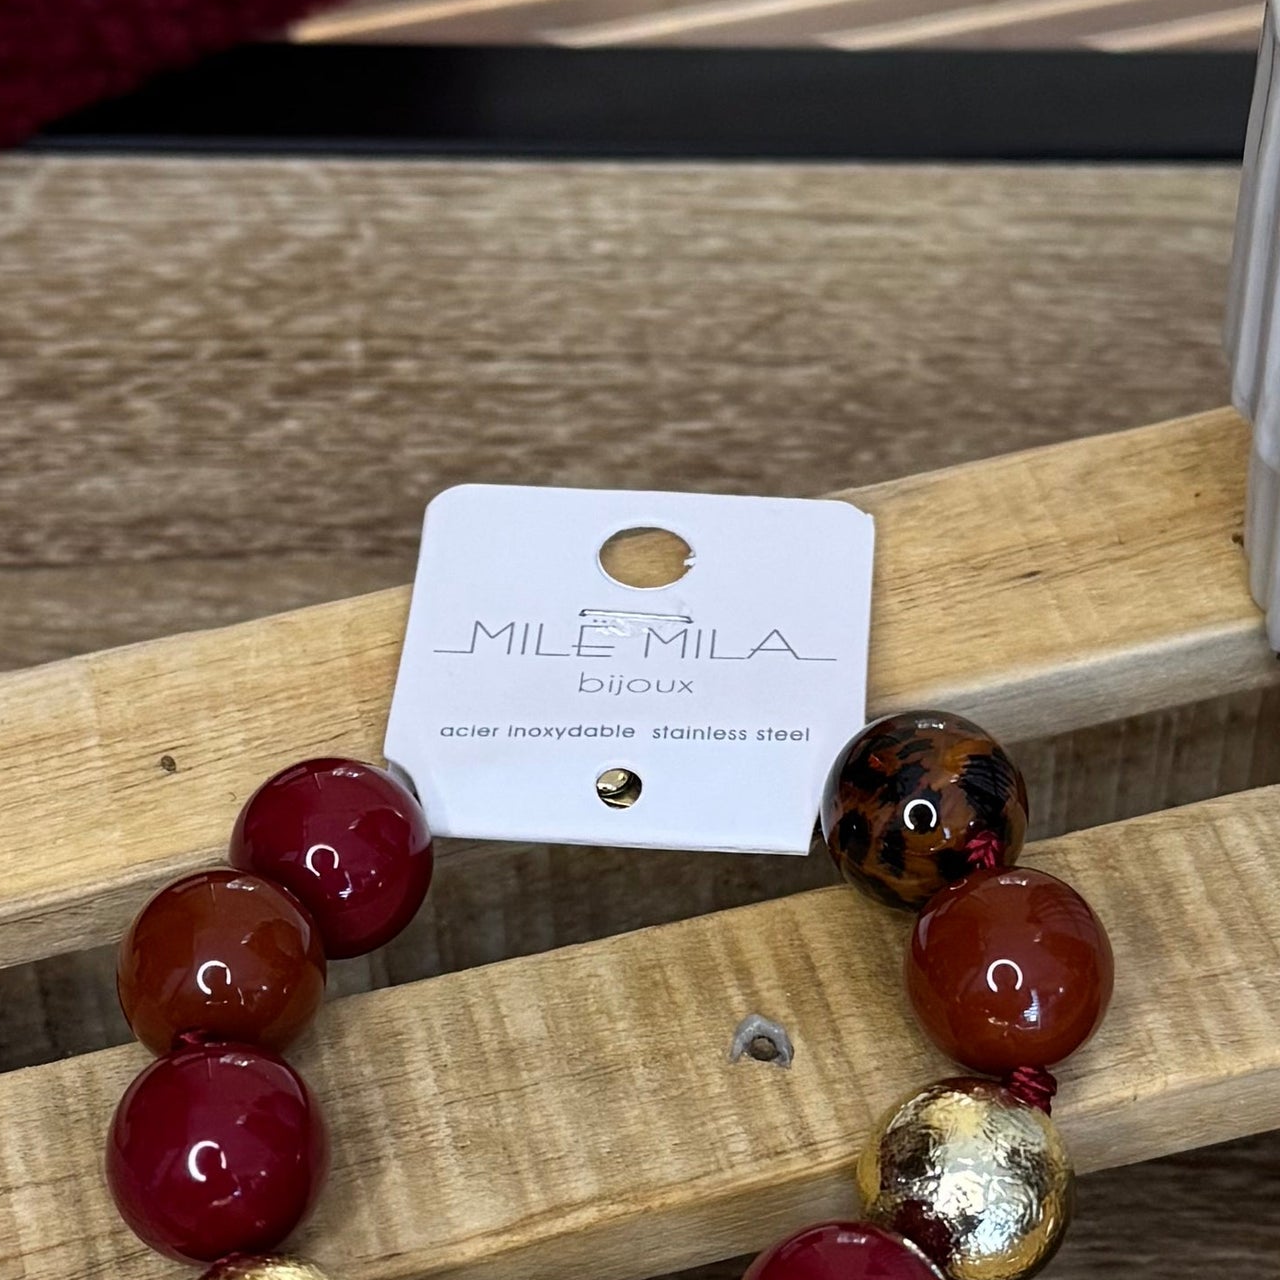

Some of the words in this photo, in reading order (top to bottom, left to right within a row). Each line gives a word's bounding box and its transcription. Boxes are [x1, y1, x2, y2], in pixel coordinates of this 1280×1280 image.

[643, 626, 838, 663] MILA
[578, 671, 695, 697] bijoux
[439, 723, 500, 740] acier
[507, 722, 637, 742] inoxydable
[651, 724, 749, 742] stainless
[756, 726, 812, 744] steel
